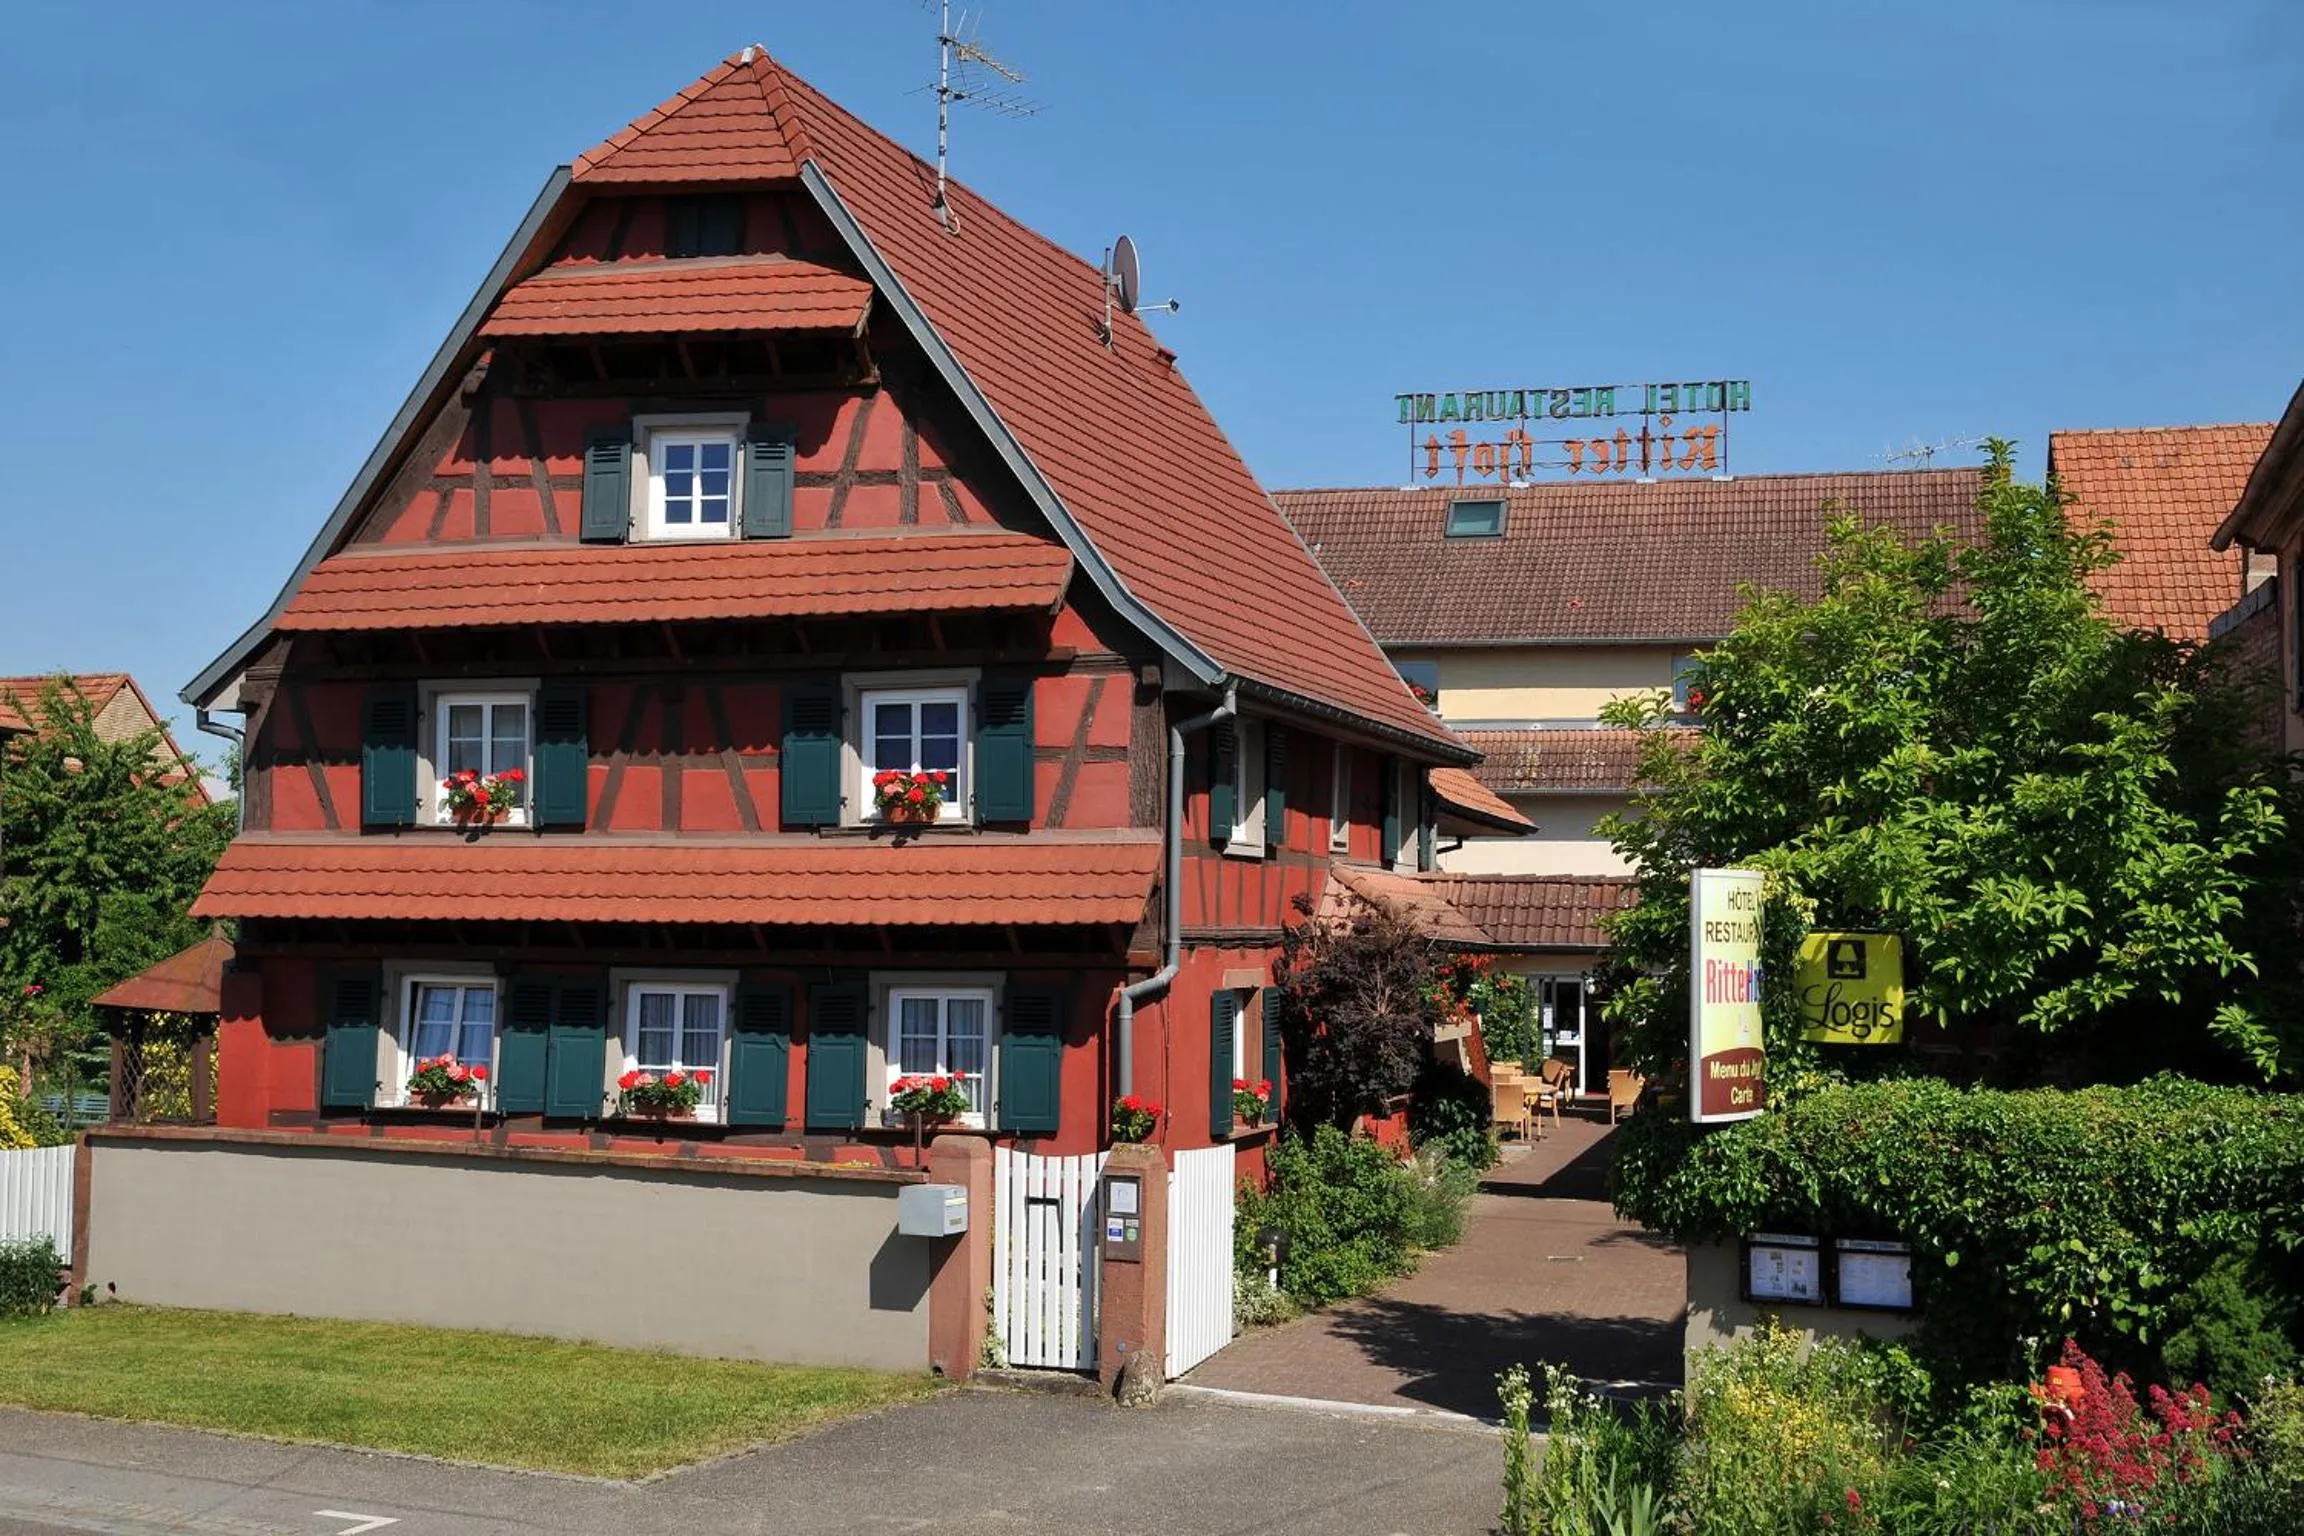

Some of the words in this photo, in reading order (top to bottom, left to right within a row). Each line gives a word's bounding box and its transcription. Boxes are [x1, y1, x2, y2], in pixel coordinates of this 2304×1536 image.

[1801, 981, 1895, 1038] Logis
[1710, 1060, 1738, 1079] Menu
[1740, 1059, 1750, 1077] du
[1731, 1086, 1754, 1105] Carte
